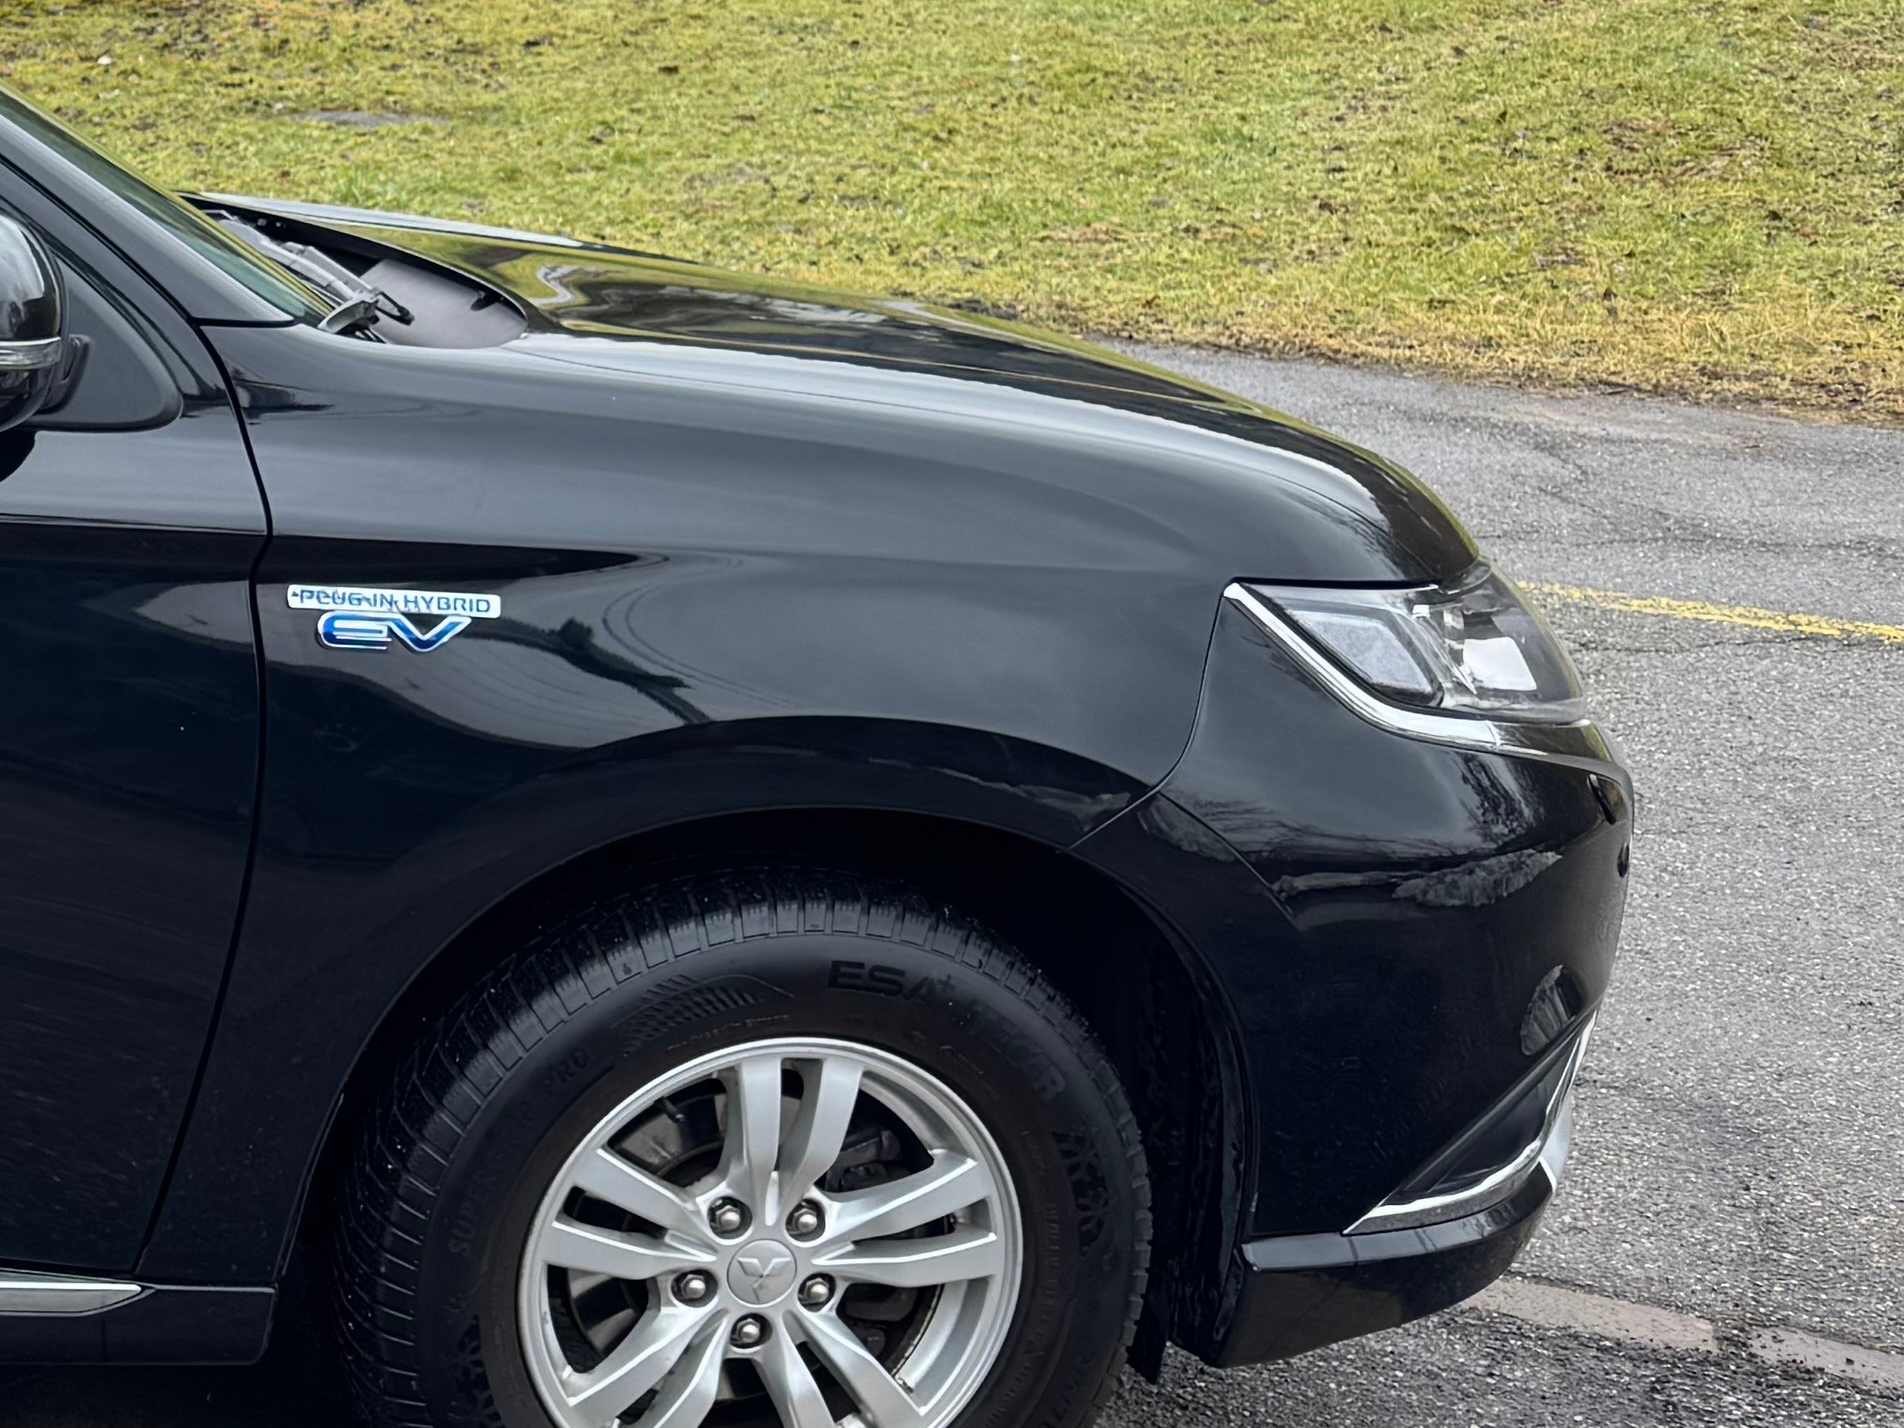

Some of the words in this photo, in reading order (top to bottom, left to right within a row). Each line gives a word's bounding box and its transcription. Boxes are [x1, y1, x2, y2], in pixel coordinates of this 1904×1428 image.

[300, 589, 394, 608] PLUG-IN
[404, 594, 491, 613] HYBRID
[318, 611, 472, 652] EV
